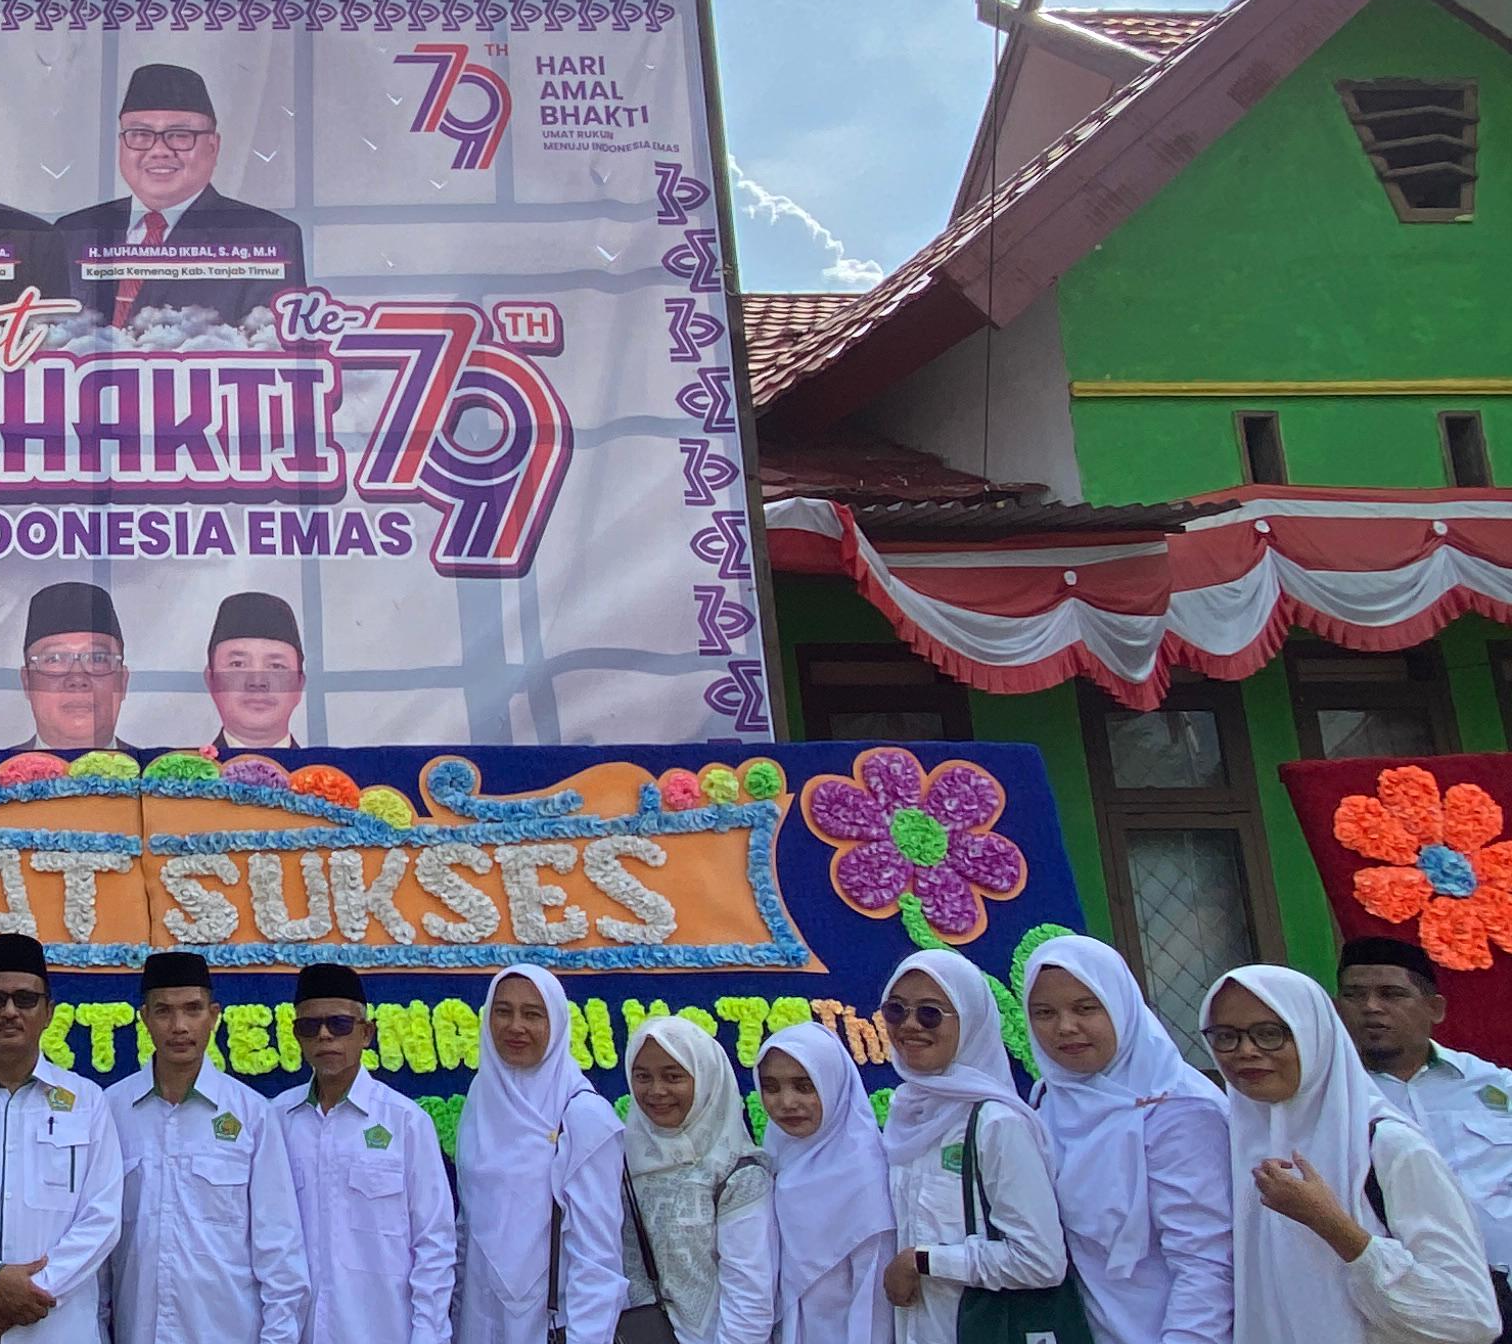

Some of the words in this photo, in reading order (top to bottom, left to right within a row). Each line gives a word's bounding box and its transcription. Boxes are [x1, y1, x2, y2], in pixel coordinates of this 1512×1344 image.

[484, 43, 509, 56] TH
[536, 55, 606, 76] HARI
[539, 80, 624, 101] AMAL
[393, 43, 513, 170] 79
[540, 105, 649, 128] BHAKTI
[542, 130, 574, 139] UMAT
[576, 130, 614, 140] RUKUN
[543, 142, 590, 151] MENUJU
[592, 140, 651, 153] INDONESIA
[652, 142, 680, 153] EMAS
[102, 246, 178, 258] MUHAMMAD
[253, 246, 277, 257] M.H
[87, 267, 125, 278] Kepala
[126, 266, 180, 278] Kemenag
[181, 265, 207, 276] Kab.
[207, 266, 246, 278] Tanjab
[247, 266, 281, 276] Timur
[501, 309, 552, 340] TH
[334, 307, 566, 564] 79
[249, 509, 414, 556] EMAS
[160, 833, 677, 946] SUKSES
